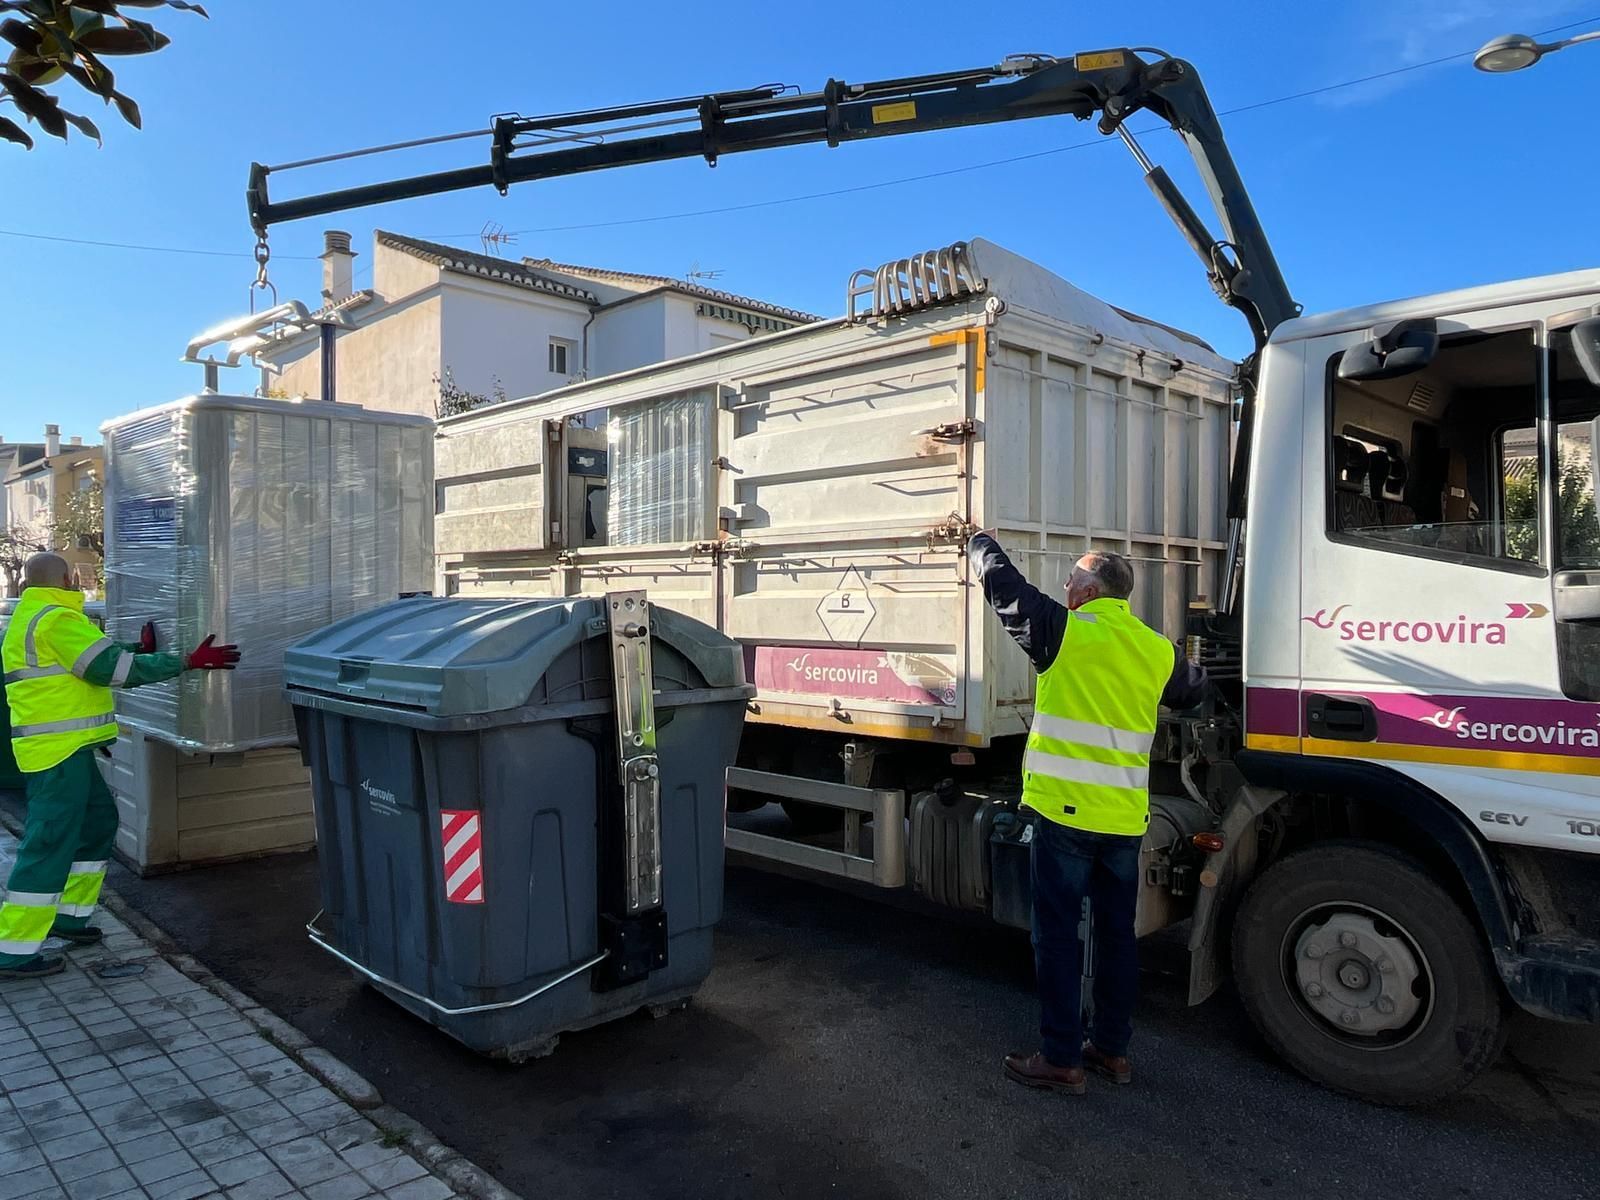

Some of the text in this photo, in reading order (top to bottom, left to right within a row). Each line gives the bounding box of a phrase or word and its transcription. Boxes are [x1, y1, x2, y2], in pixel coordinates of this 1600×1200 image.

[1340, 615, 1506, 645] sercovira
[804, 663, 878, 685] sercovira
[1456, 720, 1599, 748] sercovira
[1479, 810, 1529, 827] EEV
[1565, 820, 1600, 837] 10
